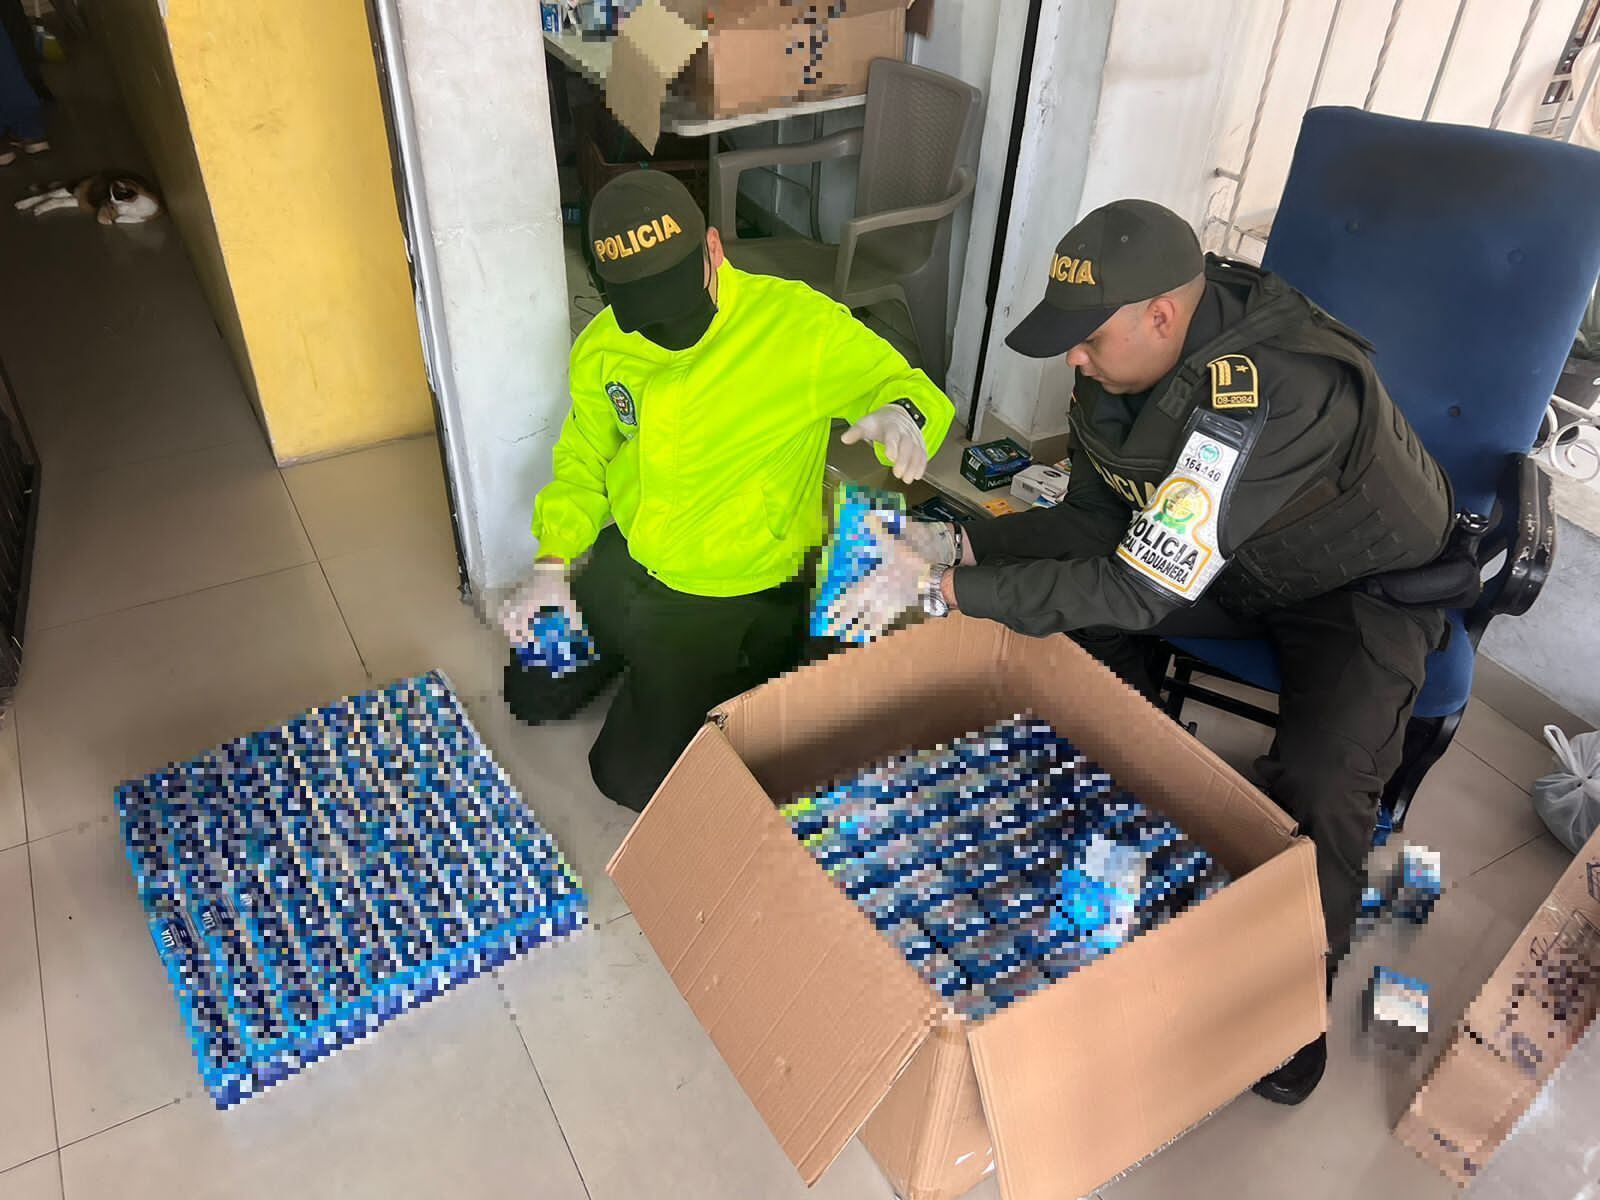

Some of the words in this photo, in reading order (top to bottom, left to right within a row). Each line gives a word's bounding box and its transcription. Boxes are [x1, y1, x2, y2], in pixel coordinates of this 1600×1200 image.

[594, 214, 682, 262] POLICIA
[1050, 253, 1096, 285] ICIA
[1135, 543, 1145, 556] Y
[1142, 547, 1190, 584] ADUANERA
